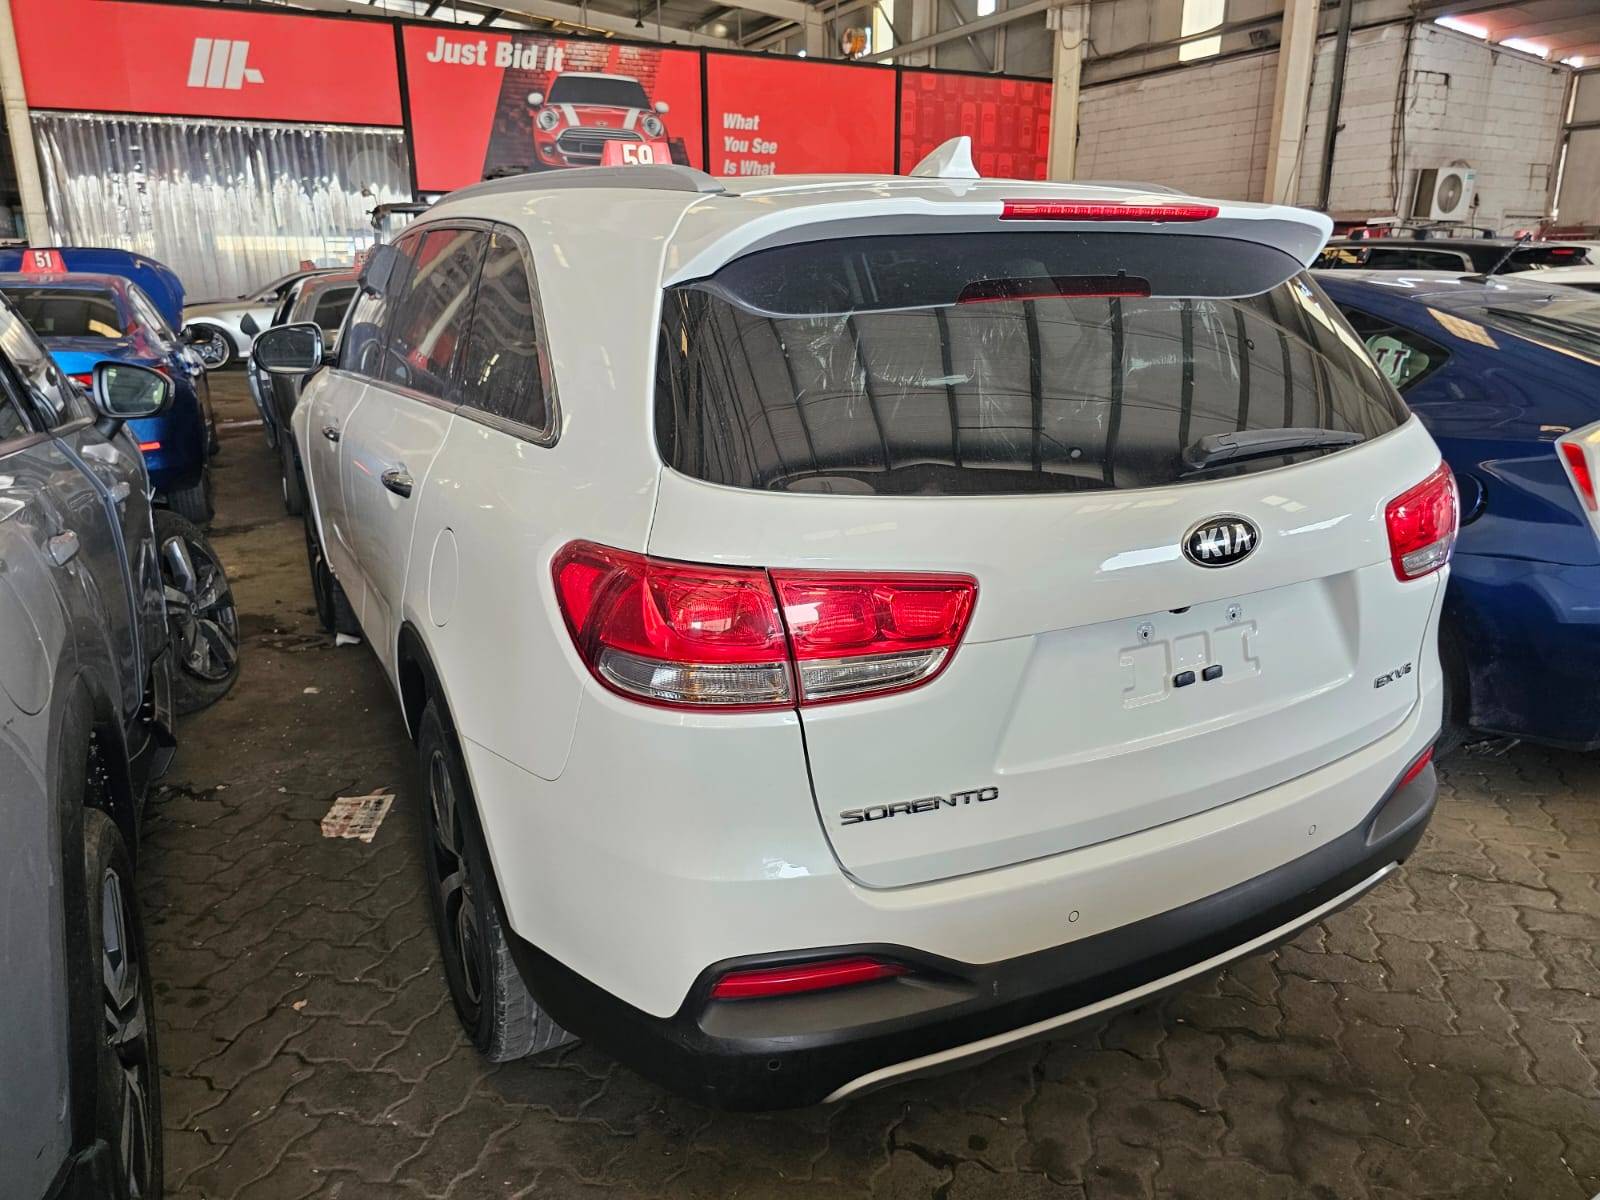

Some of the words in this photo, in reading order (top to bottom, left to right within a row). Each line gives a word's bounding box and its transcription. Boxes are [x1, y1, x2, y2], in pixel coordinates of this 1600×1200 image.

[427, 36, 488, 66] Just
[495, 41, 539, 70] Bid
[545, 46, 565, 72] It
[723, 113, 760, 130] What
[724, 136, 748, 153] You
[752, 138, 778, 154] See
[723, 159, 737, 175] Is
[740, 160, 776, 176] What
[34, 250, 53, 268] 51
[1196, 523, 1252, 559] KIA
[840, 786, 999, 826] SORENTO
